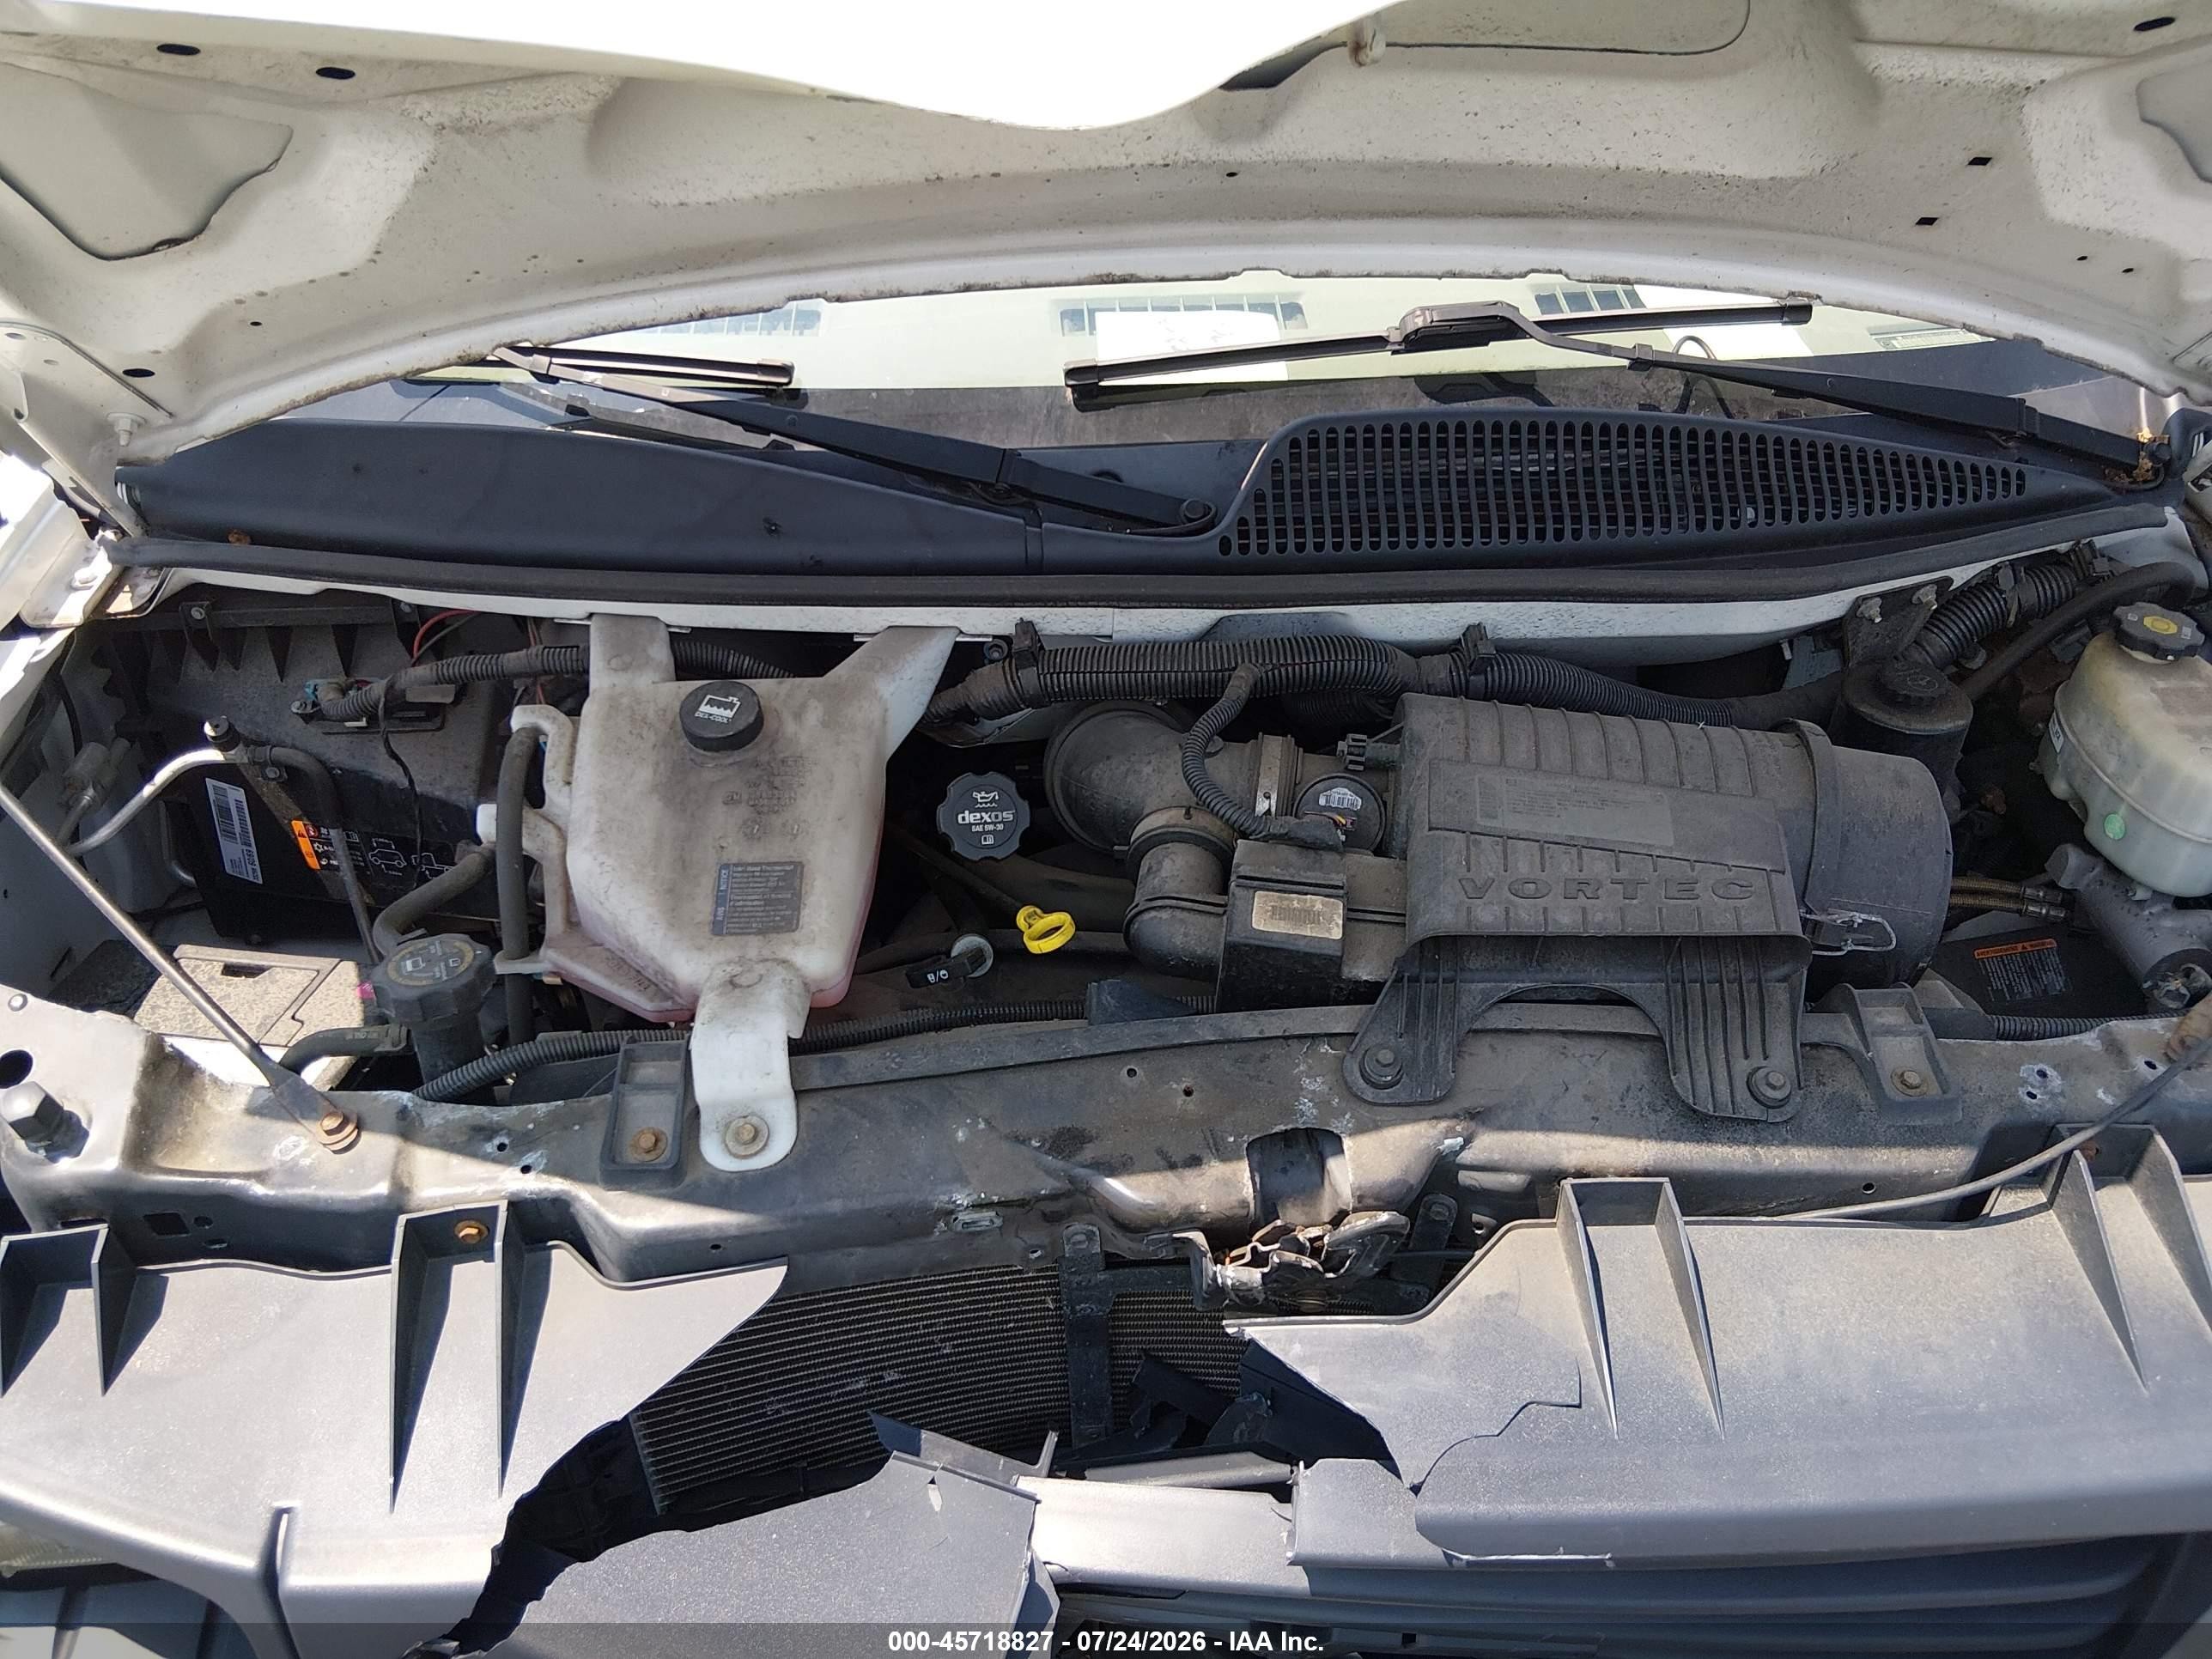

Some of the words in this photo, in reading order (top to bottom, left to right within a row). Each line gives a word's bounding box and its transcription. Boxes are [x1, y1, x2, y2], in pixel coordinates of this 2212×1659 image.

[957, 810, 1015, 824] dexos
[984, 823, 1004, 832] 5W-30
[1458, 878, 1754, 901] VORTEC
